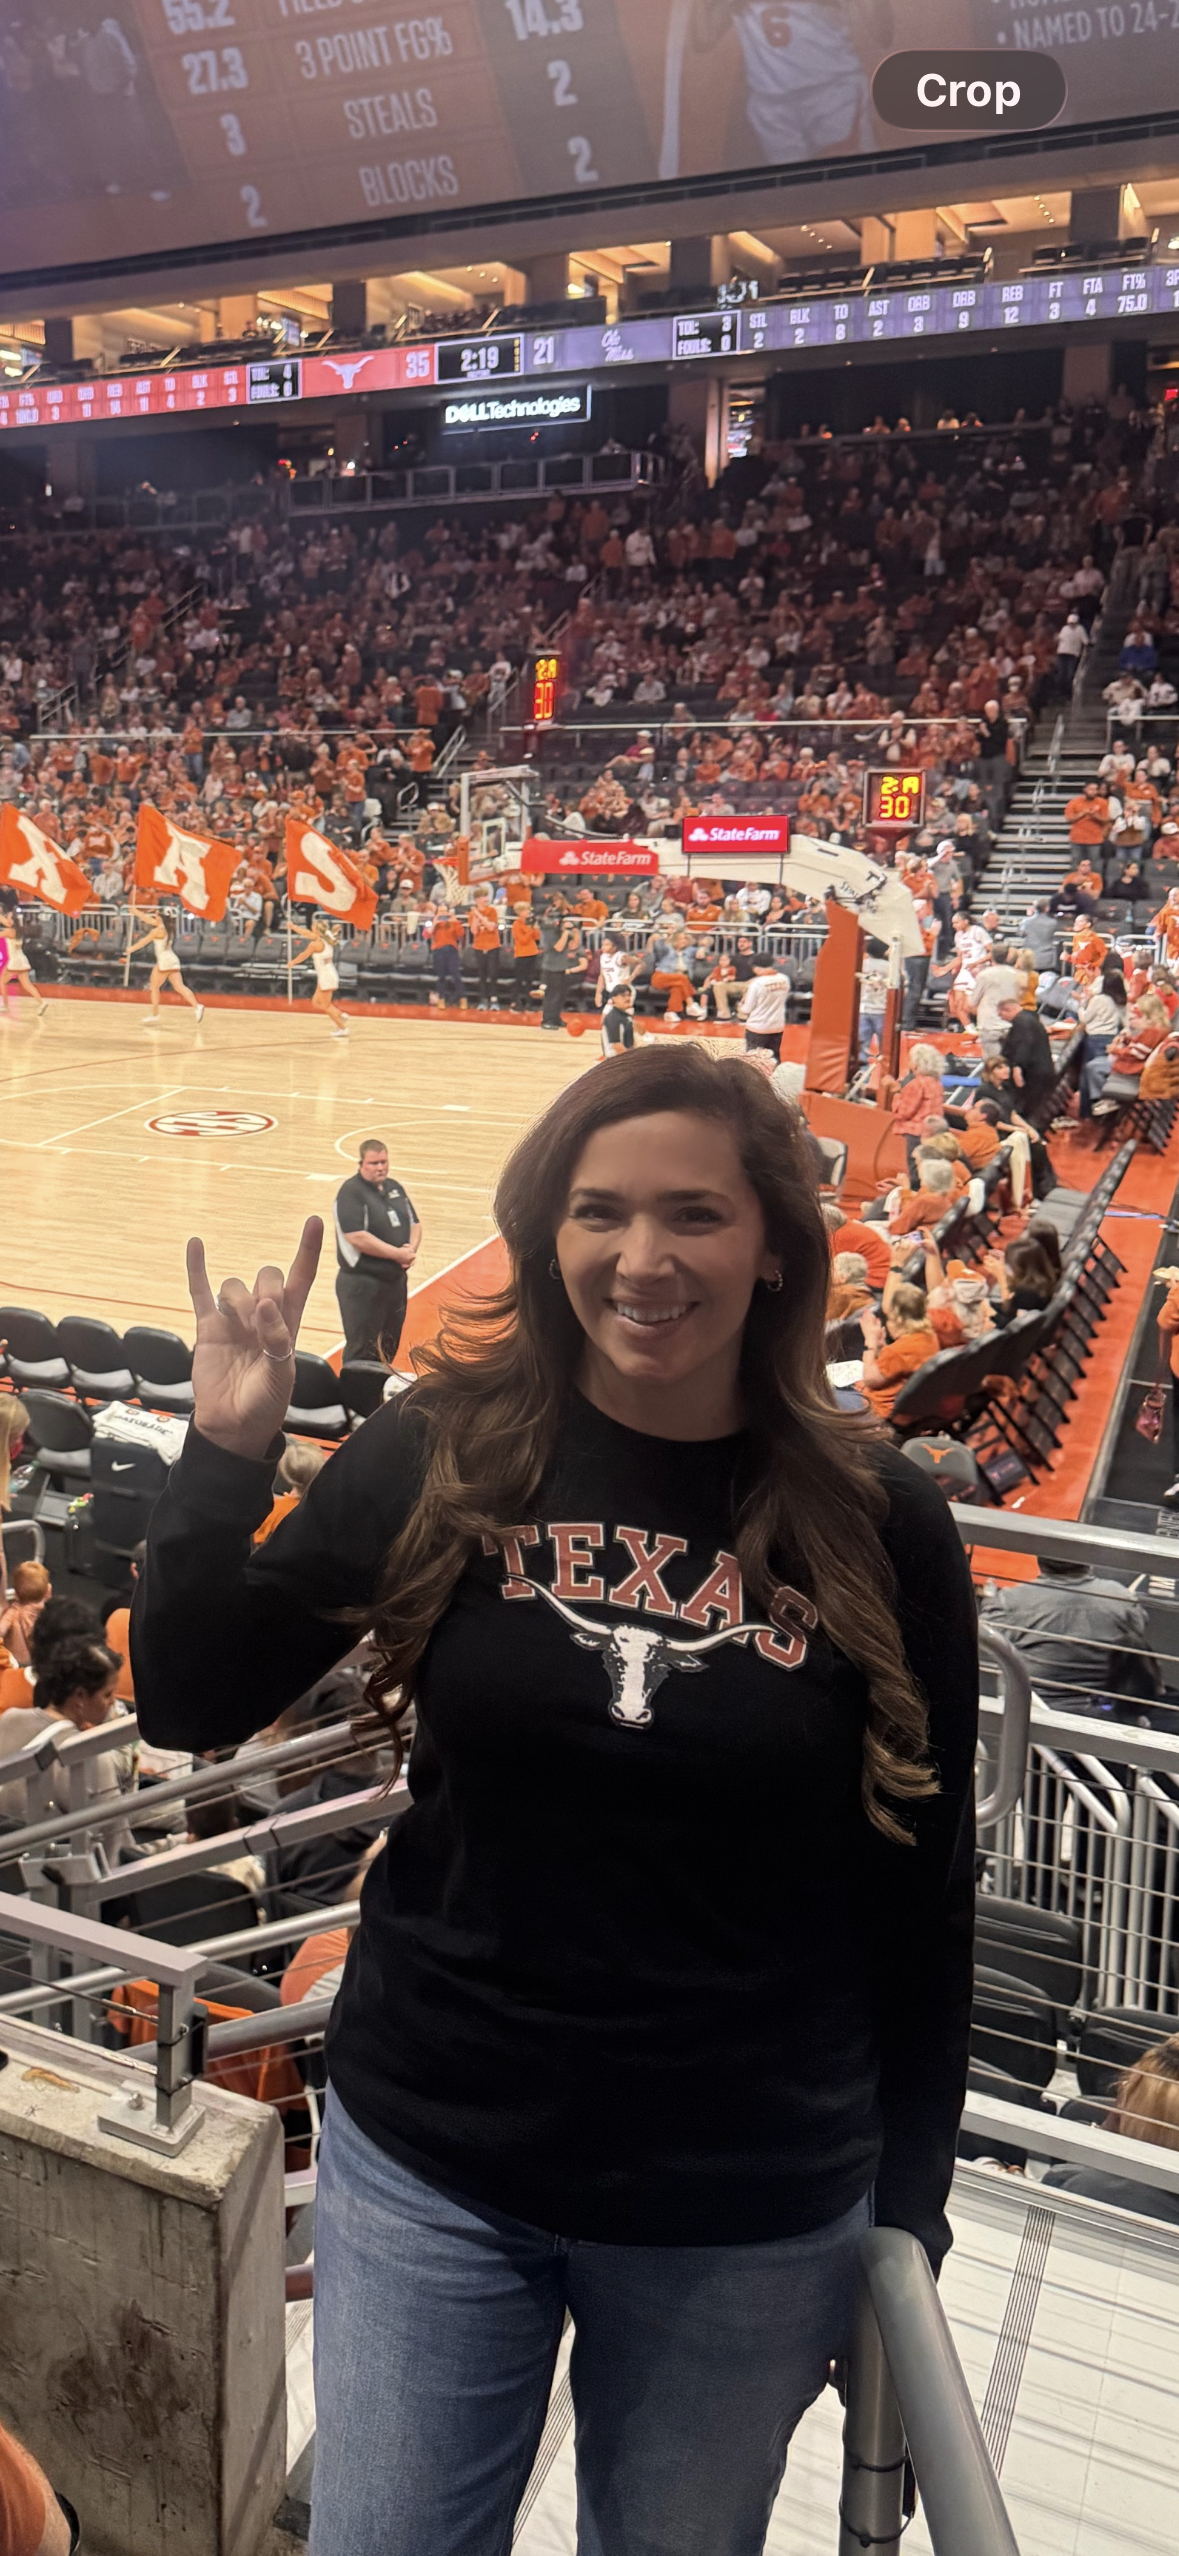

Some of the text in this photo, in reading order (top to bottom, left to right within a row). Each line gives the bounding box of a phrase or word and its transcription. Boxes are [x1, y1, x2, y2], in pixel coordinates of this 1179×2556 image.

[505, 0, 584, 40] 14.3
[1012, 10, 1093, 49] NAMED
[1097, 5, 1125, 39] TO
[182, 47, 249, 95] 27.3
[295, 19, 453, 79] 3 POINT FG%
[547, 59, 579, 106] 2
[220, 113, 247, 156] 3
[343, 87, 439, 138] STEALS
[358, 155, 460, 207] BLOCKS
[567, 135, 599, 183] 2
[240, 184, 268, 228] 2
[833, 303, 849, 320] TO
[868, 299, 890, 317] AST
[1048, 282, 1064, 298] FT
[1083, 277, 1103, 295] FTA
[1122, 273, 1146, 291] FT%
[721, 315, 732, 332] 3
[721, 334, 731, 351] 0
[753, 331, 764, 349] 2
[794, 327, 805, 344] 2
[835, 323, 846, 341] 8
[873, 320, 884, 337] 2
[958, 311, 970, 329] 9
[1004, 306, 1019, 324] 12
[1049, 302, 1060, 320] 3
[1085, 298, 1096, 316] 4
[1117, 293, 1147, 313] 75.0
[405, 350, 430, 379] 35
[460, 345, 499, 372] 2:19
[533, 336, 555, 365] 21
[196, 390, 205, 406] 2
[228, 386, 237, 403] 3
[487, 396, 581, 419] Technologies
[534, 682, 554, 719] 30
[880, 795, 910, 818] 30
[295, 831, 358, 911] S
[482, 1522, 818, 1671] TEXAS
